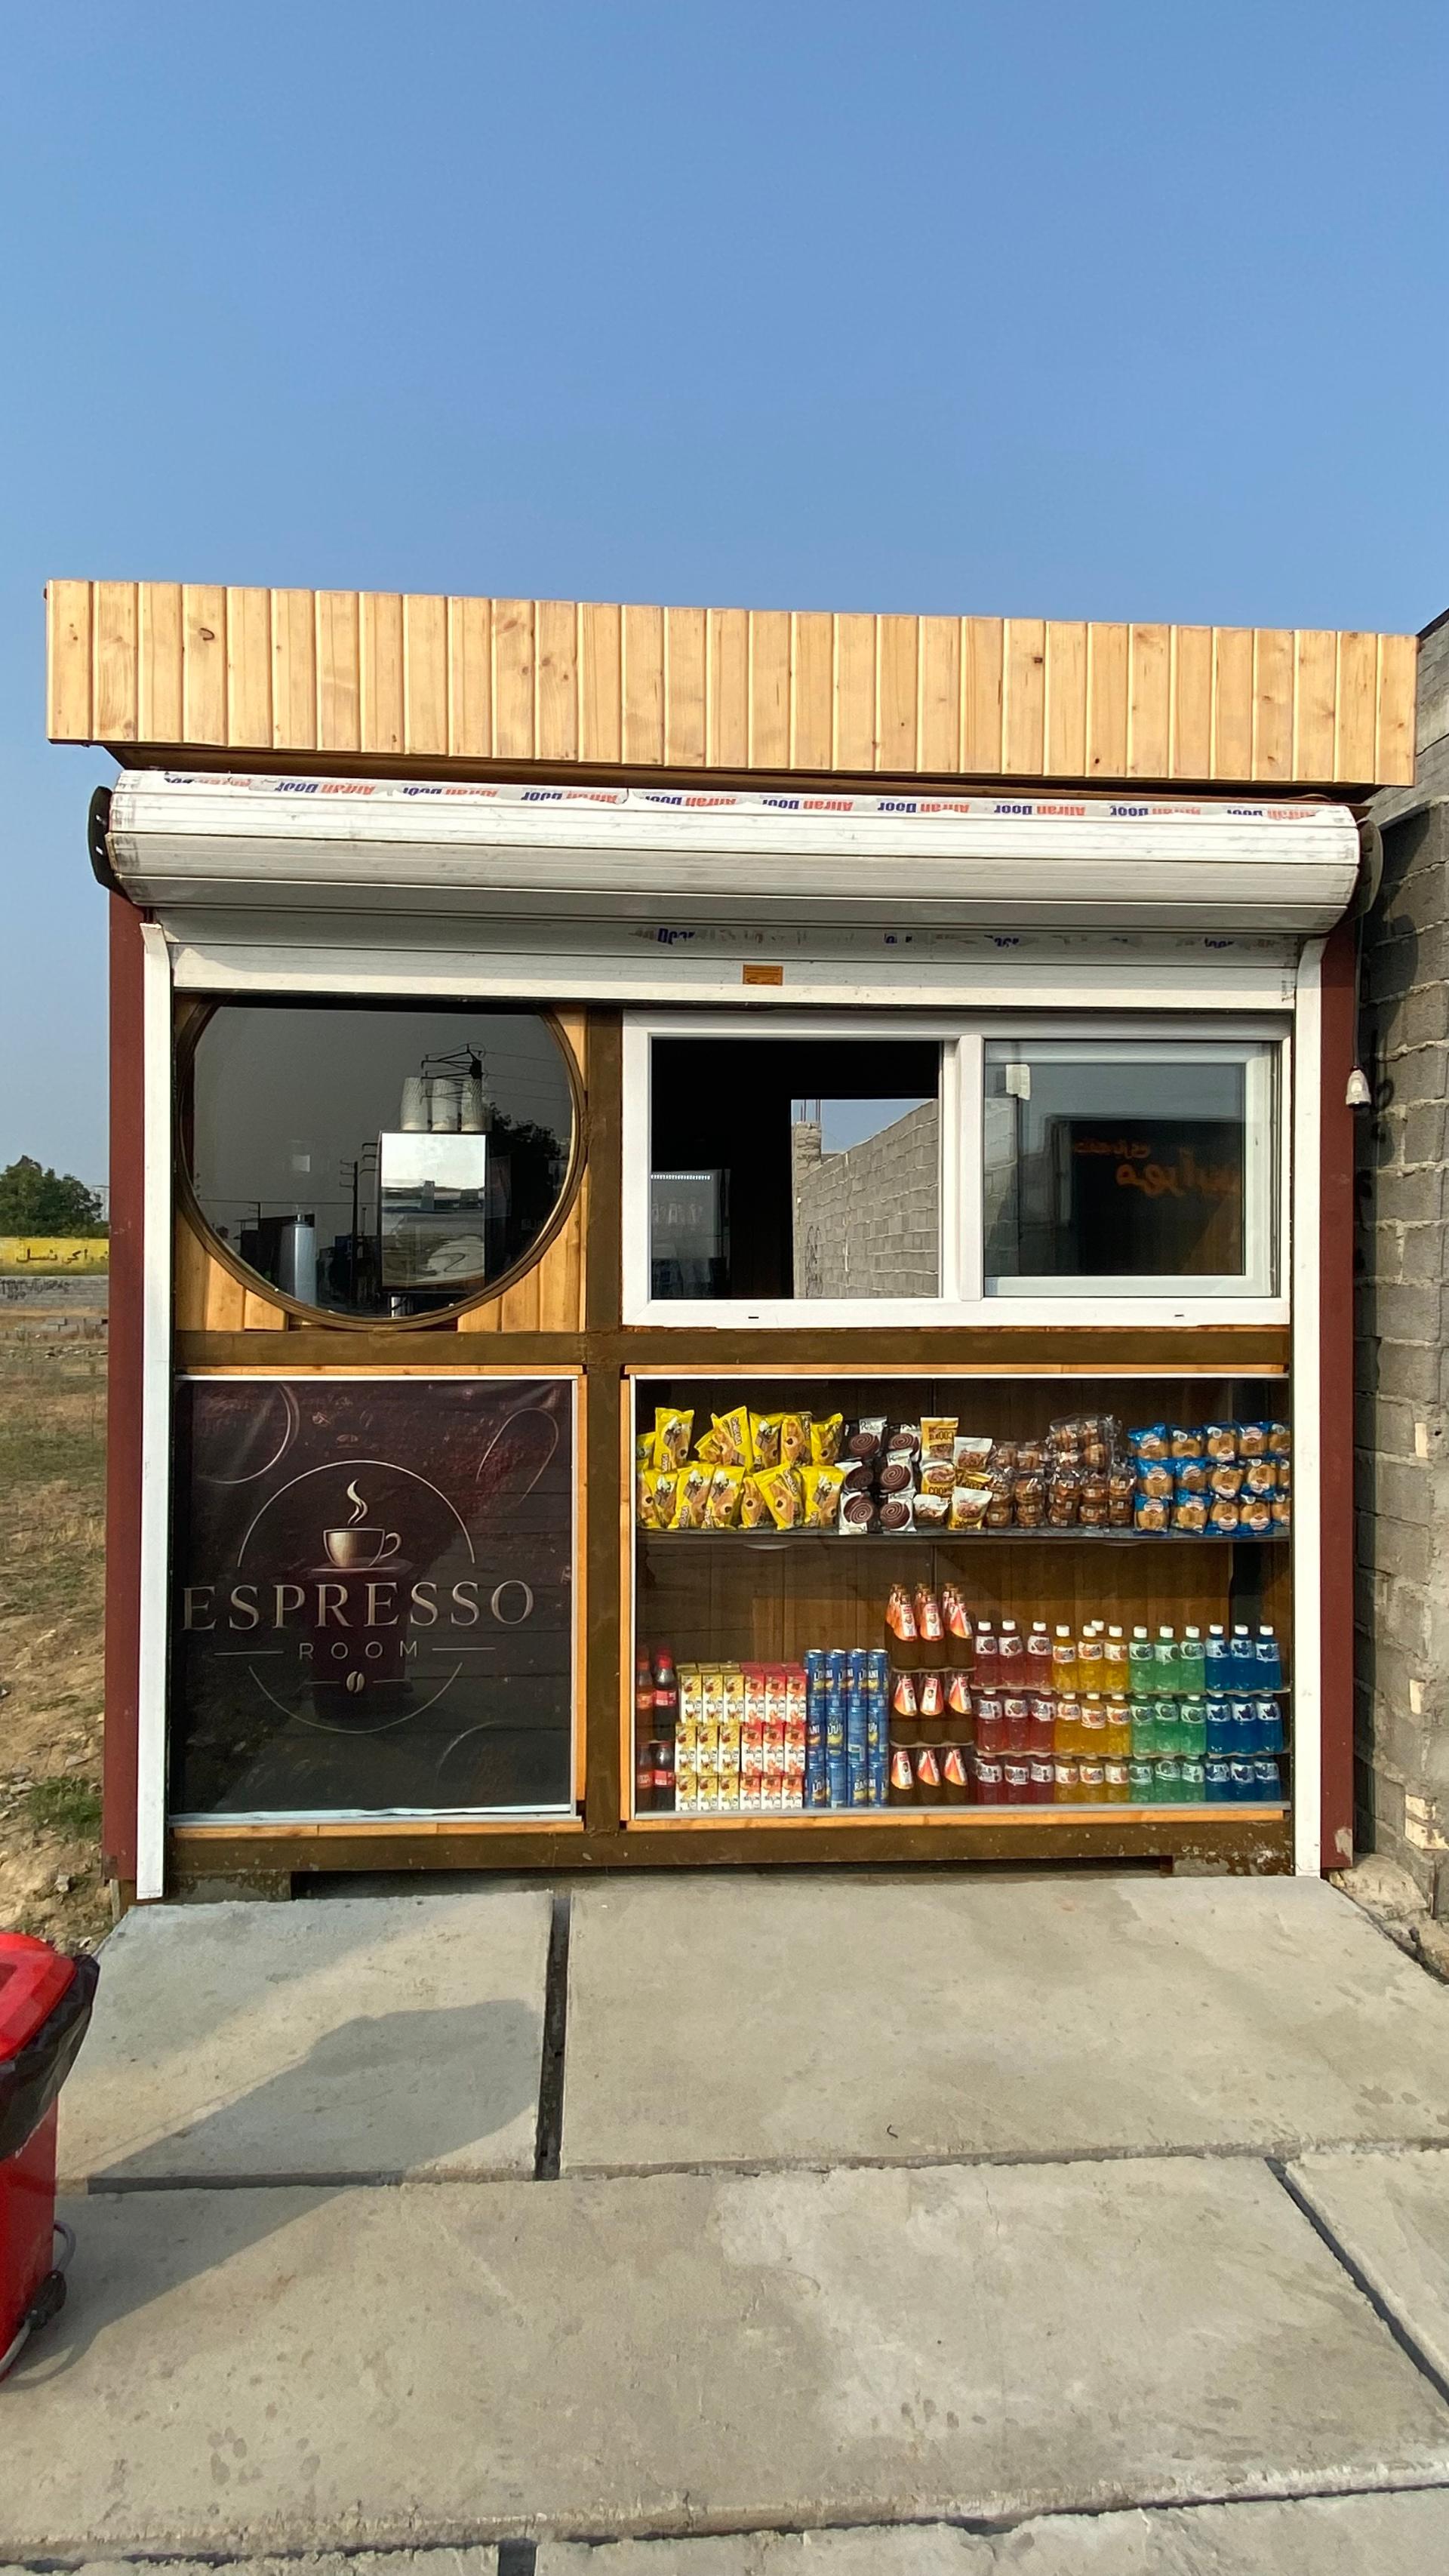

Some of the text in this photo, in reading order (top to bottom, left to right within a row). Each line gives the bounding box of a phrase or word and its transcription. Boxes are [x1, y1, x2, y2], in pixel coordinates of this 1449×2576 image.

[877, 802, 917, 814] Door
[993, 805, 1032, 815] Door
[181, 1579, 535, 1632] ESPRESSO
[299, 1640, 418, 1660] ROOM
